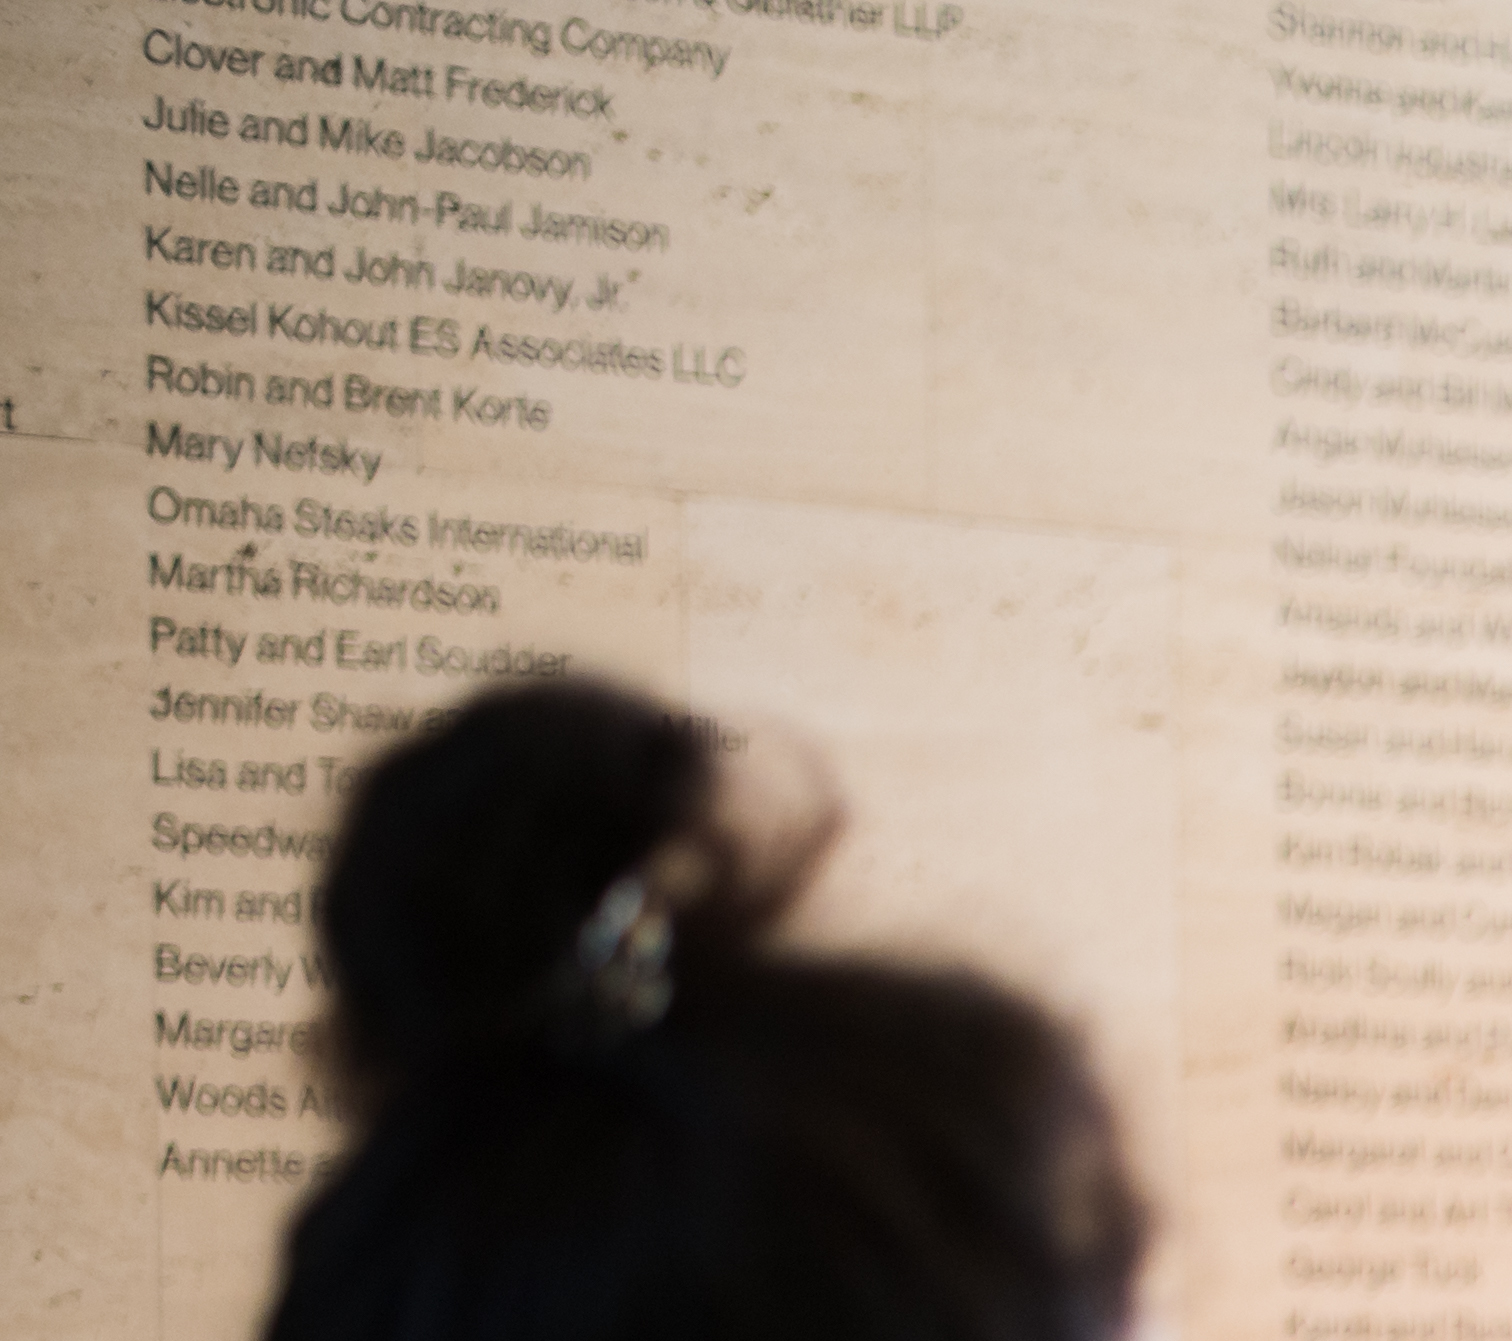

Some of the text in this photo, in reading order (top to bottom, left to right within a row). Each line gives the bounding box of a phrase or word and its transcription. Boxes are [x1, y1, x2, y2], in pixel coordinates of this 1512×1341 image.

[340, 0, 553, 56] Contracting
[558, 16, 732, 81] Company
[893, 0, 965, 40] LLP
[142, 27, 617, 122] Clover and Matt Frederick
[142, 95, 592, 182] Julie and Mike Jacobson
[143, 158, 672, 253] Nelle and John-Paul Jamison
[143, 224, 257, 272] Karen
[266, 242, 336, 281] and
[343, 246, 436, 290] John
[144, 290, 748, 388] Kissel Kohout ES Associates LLC
[146, 353, 552, 432] Robin and Brent Korte
[144, 420, 382, 486] Mary Nefsky
[146, 484, 650, 565] Omaha Steaks International
[147, 550, 502, 615] Martha Richardson
[149, 616, 575, 678] Patty and Earl Scudder
[149, 685, 298, 729] Jennifer
[309, 692, 415, 734] Shaw
[152, 748, 227, 792] Lisa
[235, 756, 307, 796] and
[152, 811, 336, 861] Speedwa
[153, 878, 227, 919] Kim
[235, 890, 302, 926] and
[153, 943, 294, 992] Beverly
[153, 1008, 311, 1059] Margare
[154, 1074, 288, 1119] Woods
[159, 1140, 301, 1183] Annette
